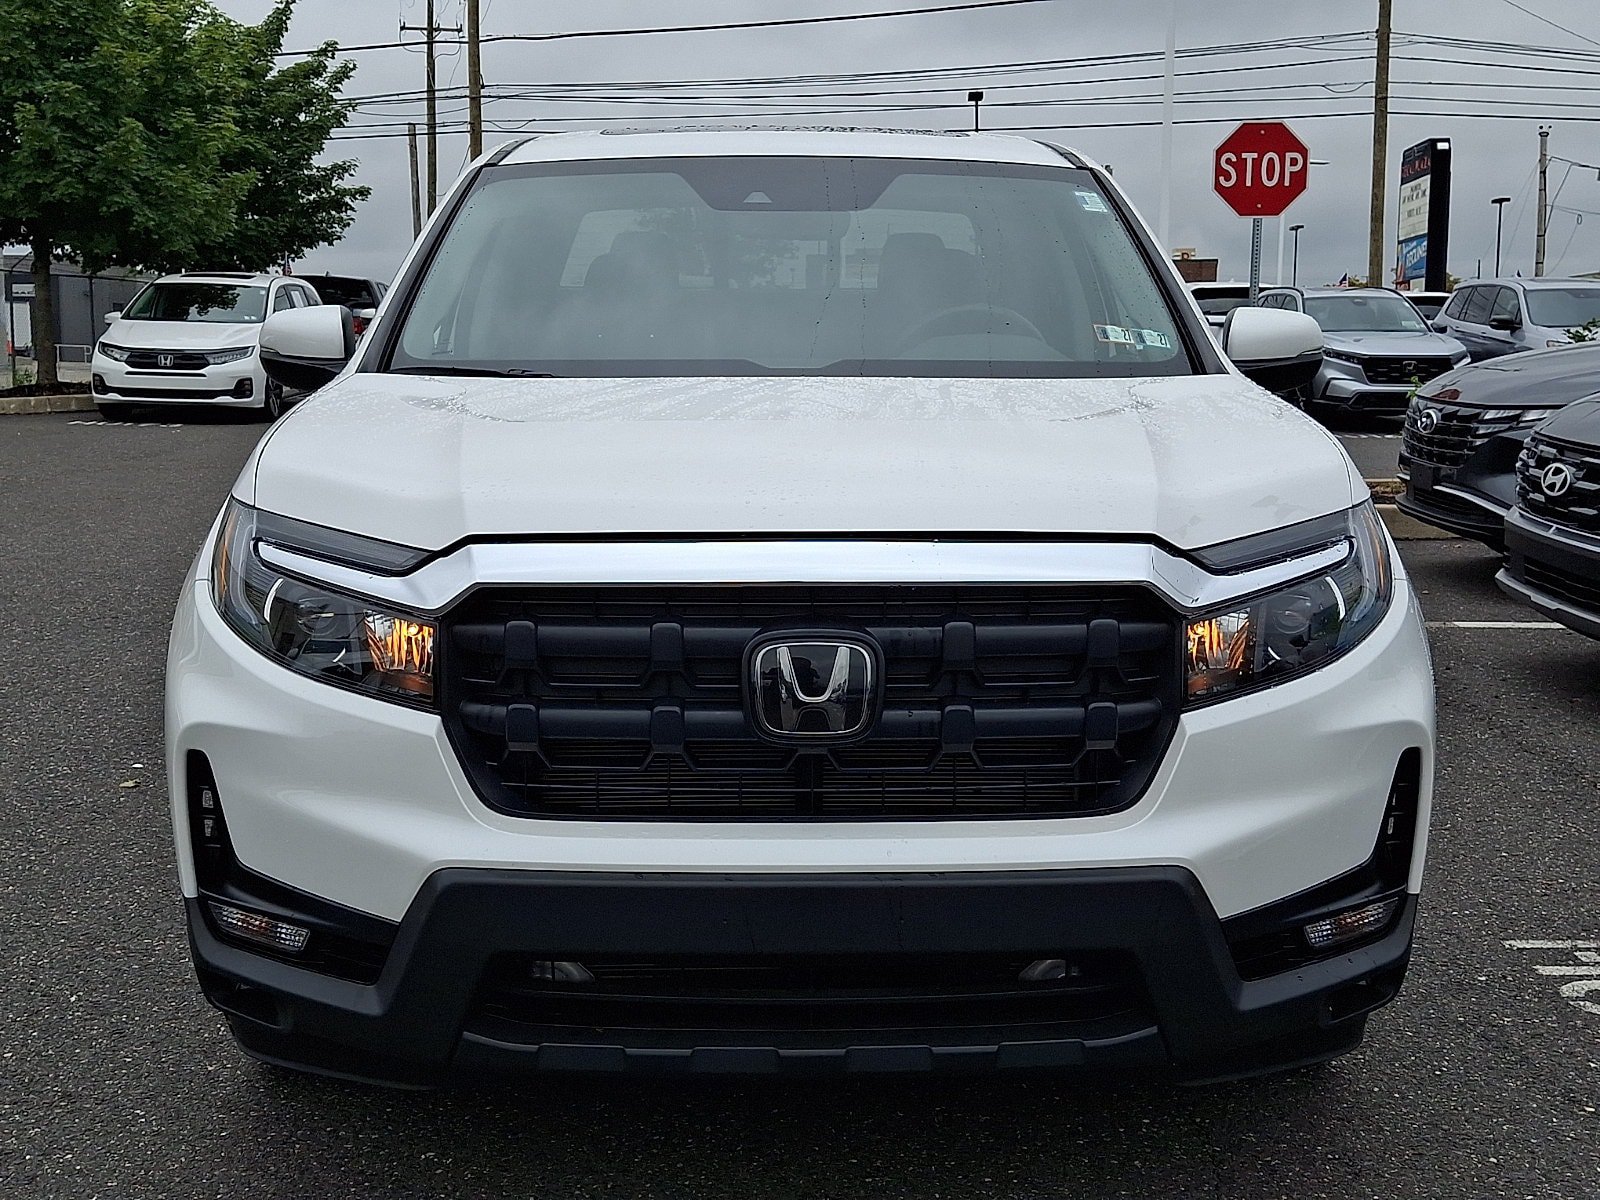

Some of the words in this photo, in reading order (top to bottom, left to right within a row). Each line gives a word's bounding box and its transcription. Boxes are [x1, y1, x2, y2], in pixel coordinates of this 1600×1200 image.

[1219, 152, 1304, 187] STOP
[1121, 328, 1132, 342] 27
[1157, 333, 1168, 347] 27
